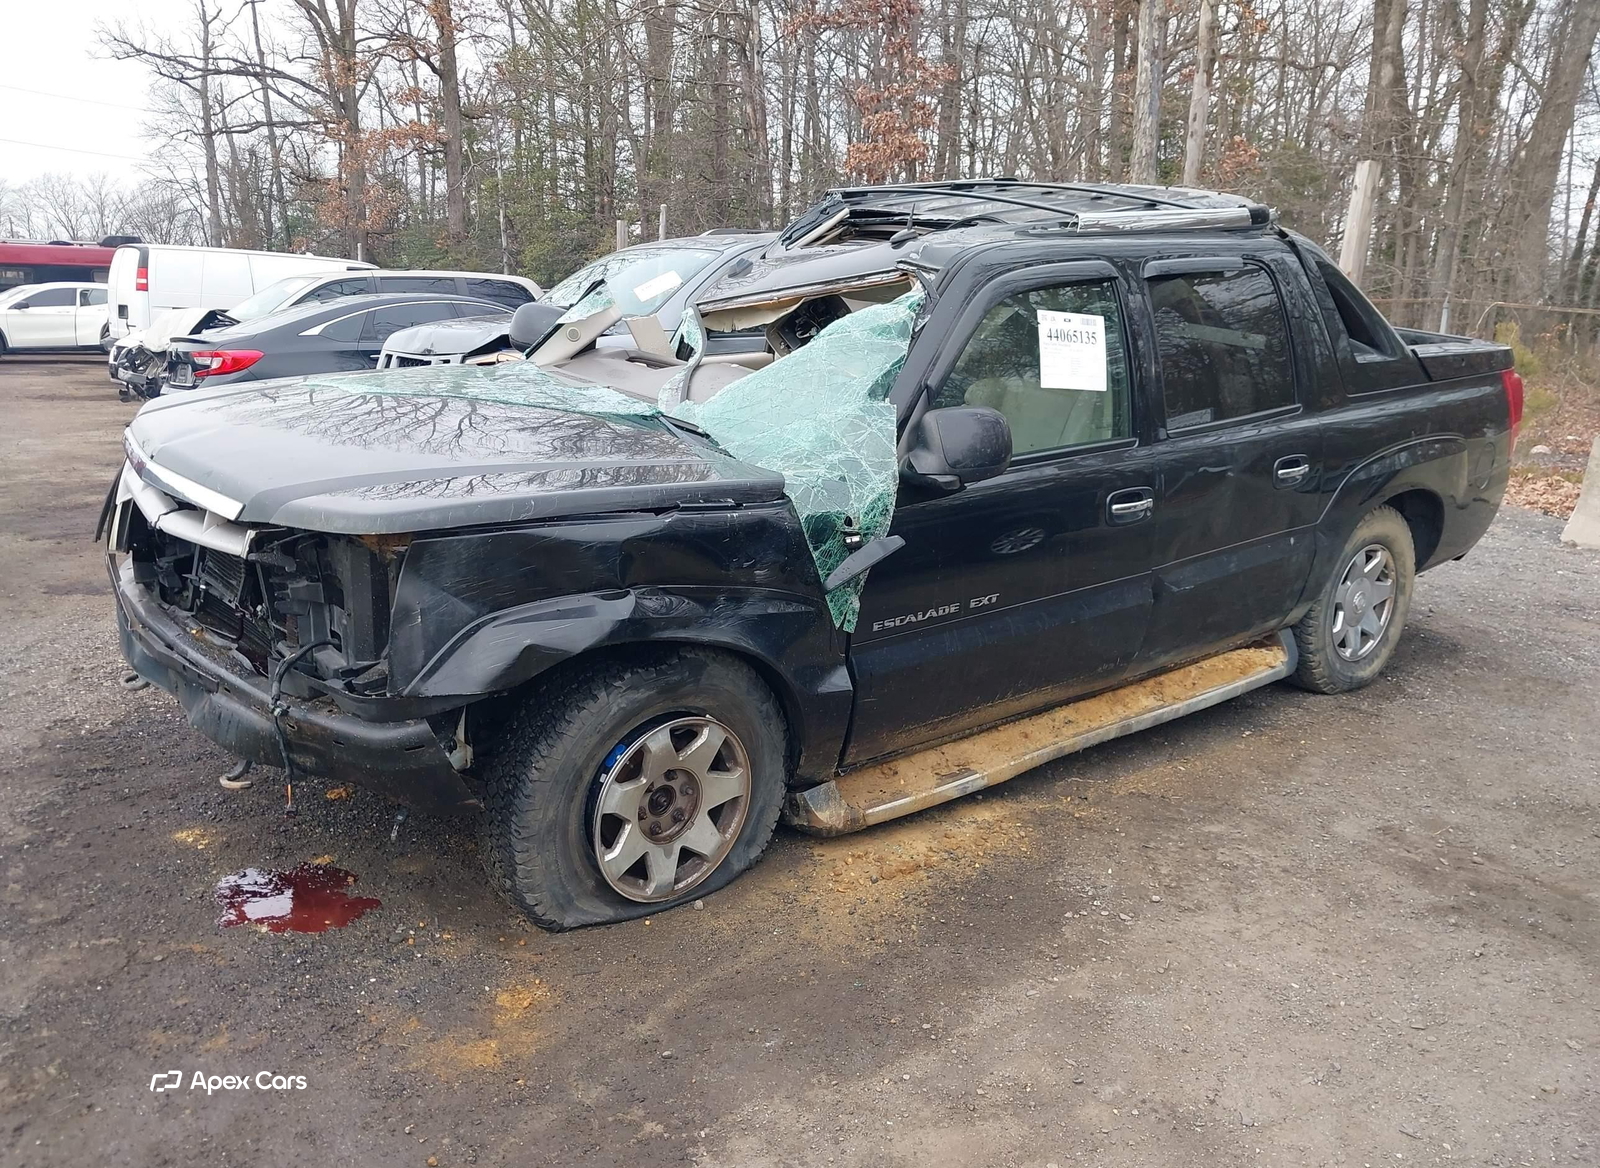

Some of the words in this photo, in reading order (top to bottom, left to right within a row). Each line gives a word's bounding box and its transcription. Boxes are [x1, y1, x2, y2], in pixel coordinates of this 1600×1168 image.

[1046, 327, 1098, 346] 44065135
[872, 602, 960, 632] ESCALADE
[969, 593, 1000, 609] EXT
